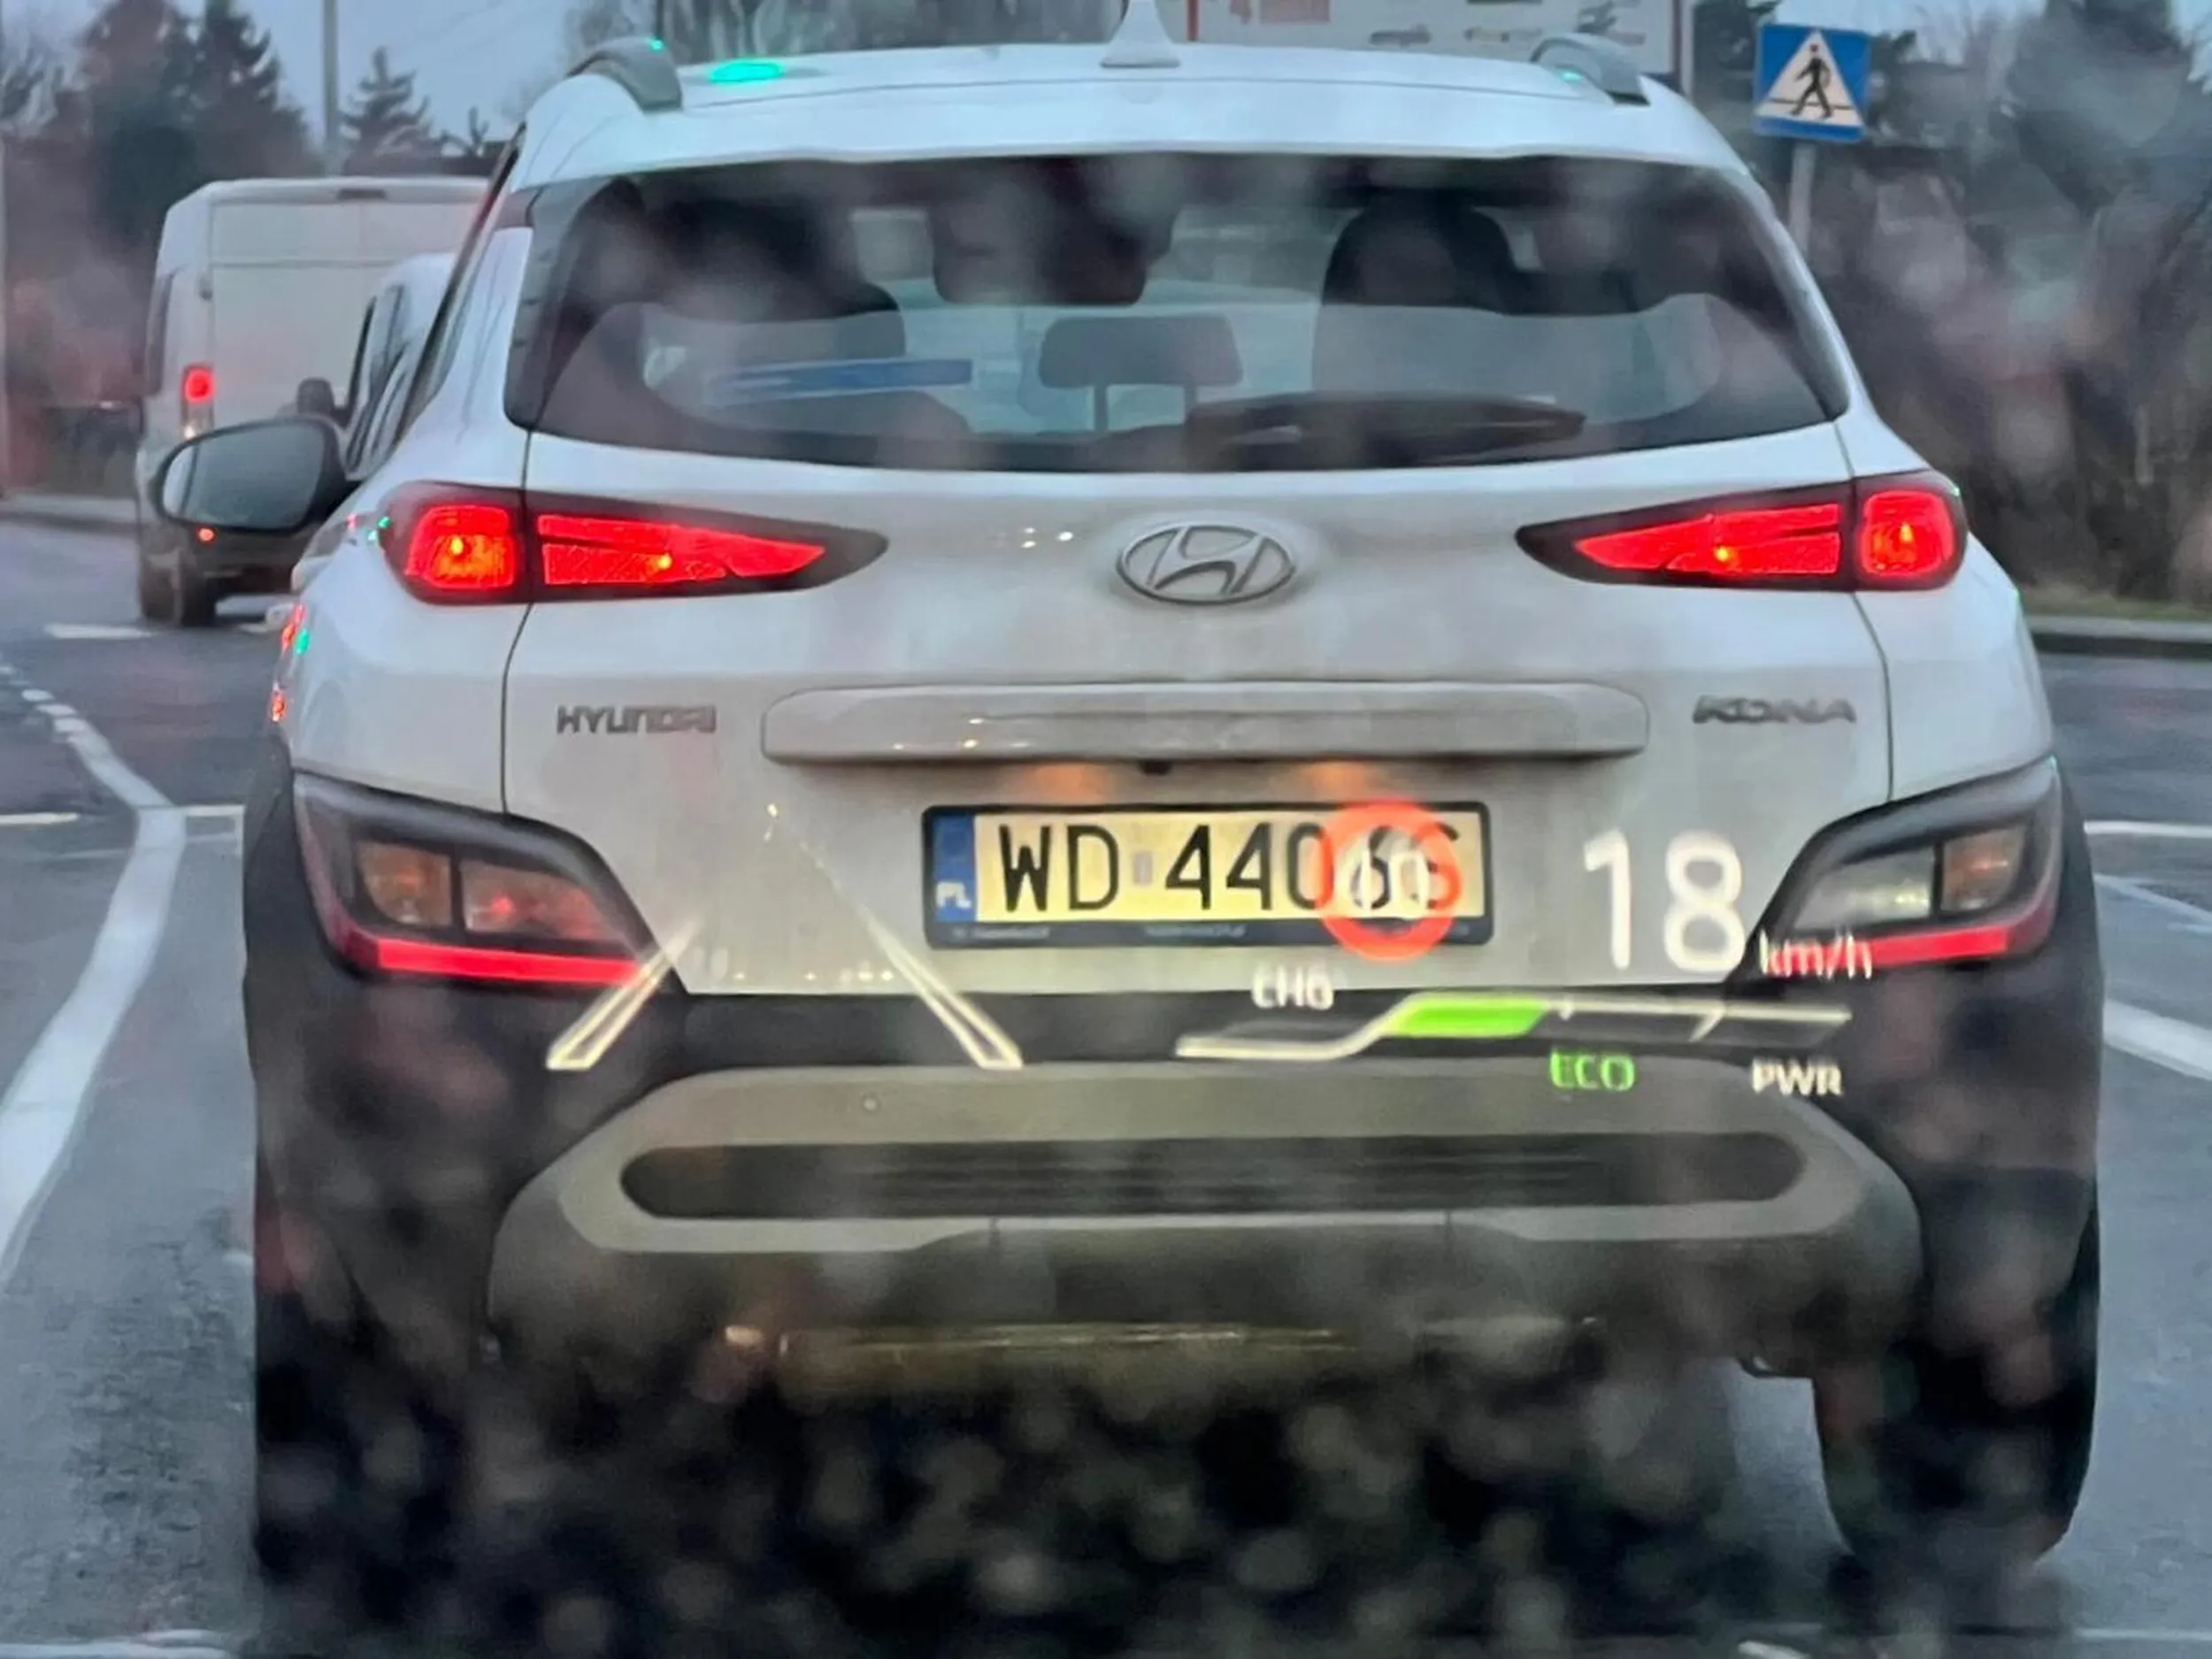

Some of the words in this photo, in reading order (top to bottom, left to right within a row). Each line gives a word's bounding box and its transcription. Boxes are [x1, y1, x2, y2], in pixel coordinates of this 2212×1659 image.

[556, 705, 718, 734] HYUNDAI
[998, 823, 1120, 912] WD
[1583, 828, 1747, 972] 18
[1758, 928, 1873, 980] km/h
[1549, 1049, 1636, 1092] ECO
[1751, 1057, 1843, 1095] PWR
